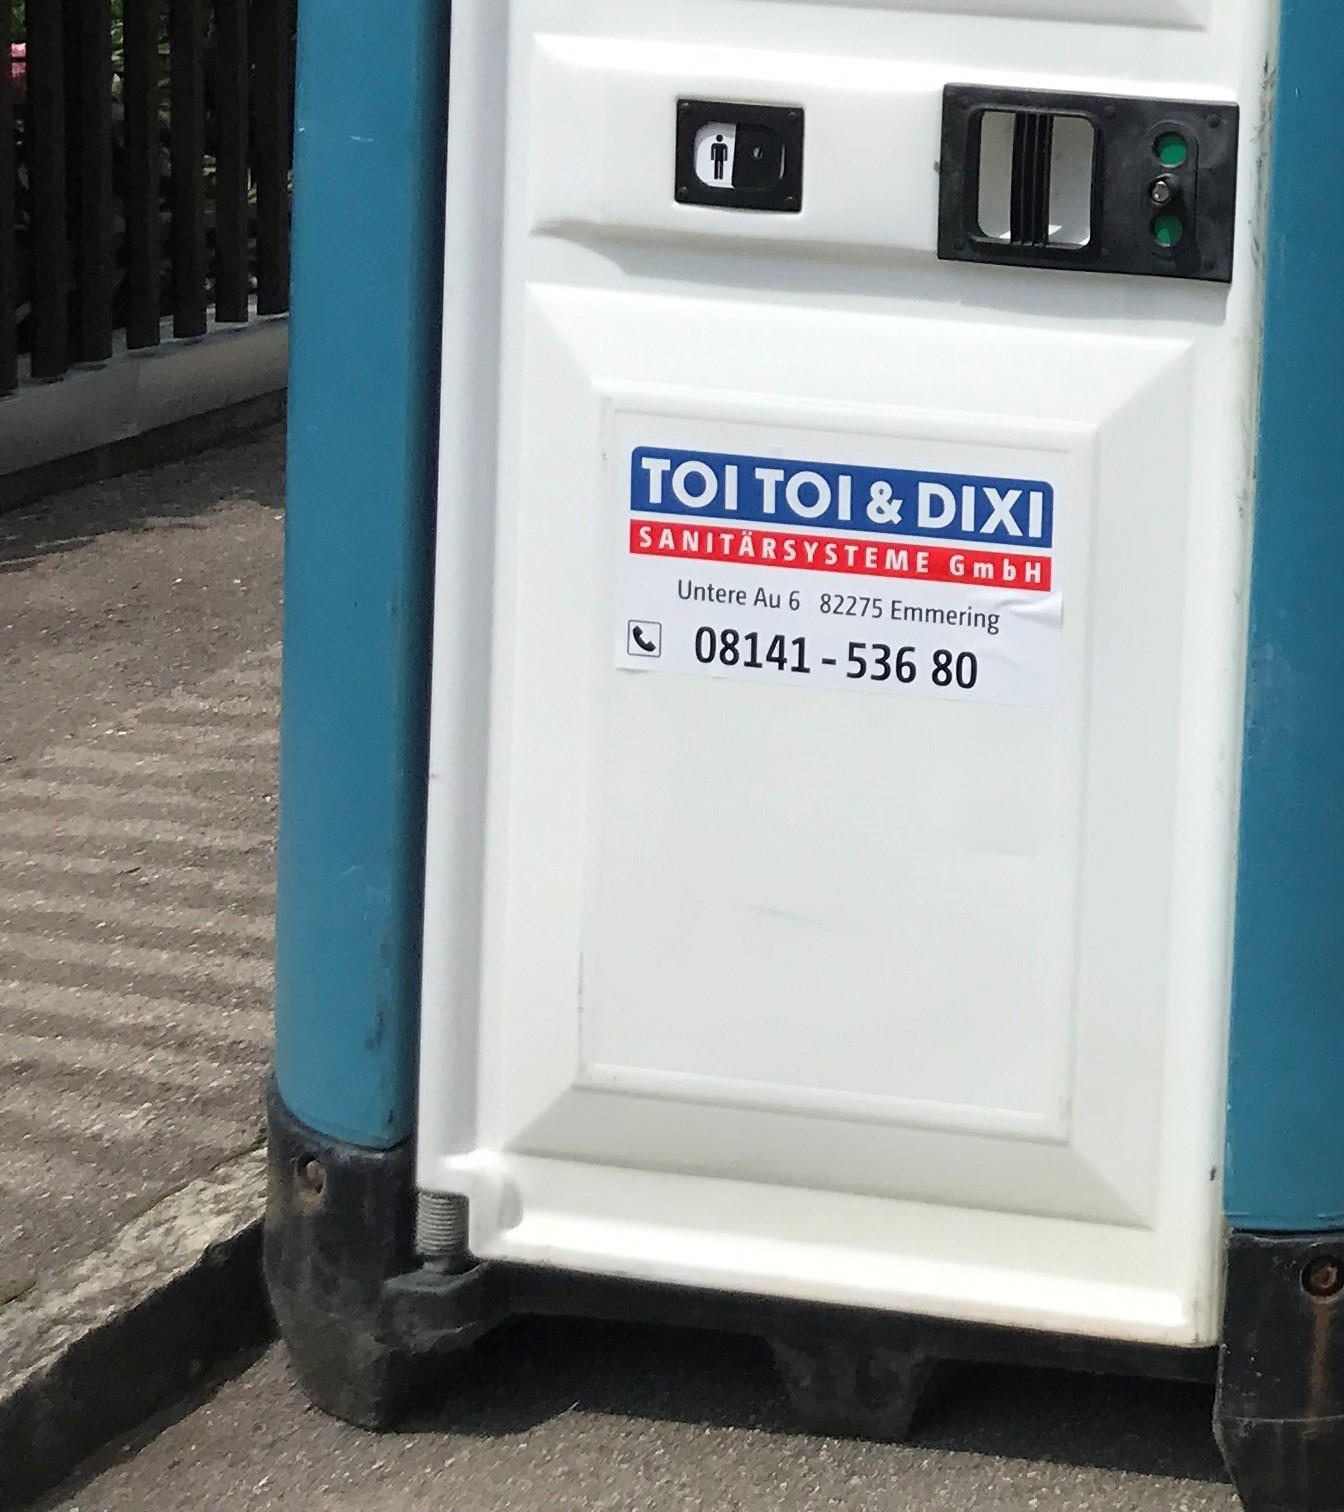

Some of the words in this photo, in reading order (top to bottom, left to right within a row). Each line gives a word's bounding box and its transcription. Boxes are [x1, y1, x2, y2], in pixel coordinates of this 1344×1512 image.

[641, 457, 738, 511] TOI
[755, 467, 851, 521] TOI
[866, 481, 903, 525] &
[918, 482, 1043, 538] DIXI
[639, 526, 930, 573] SANITÄRSYSTEME
[949, 554, 1042, 584] GmbH
[677, 579, 747, 606] Untere
[753, 587, 781, 609] Au
[788, 590, 801, 611] 6
[820, 592, 883, 619] 82275
[890, 599, 1001, 635] Emmering
[695, 626, 811, 675] 08141
[846, 641, 917, 684] 536
[931, 648, 979, 689] 80
